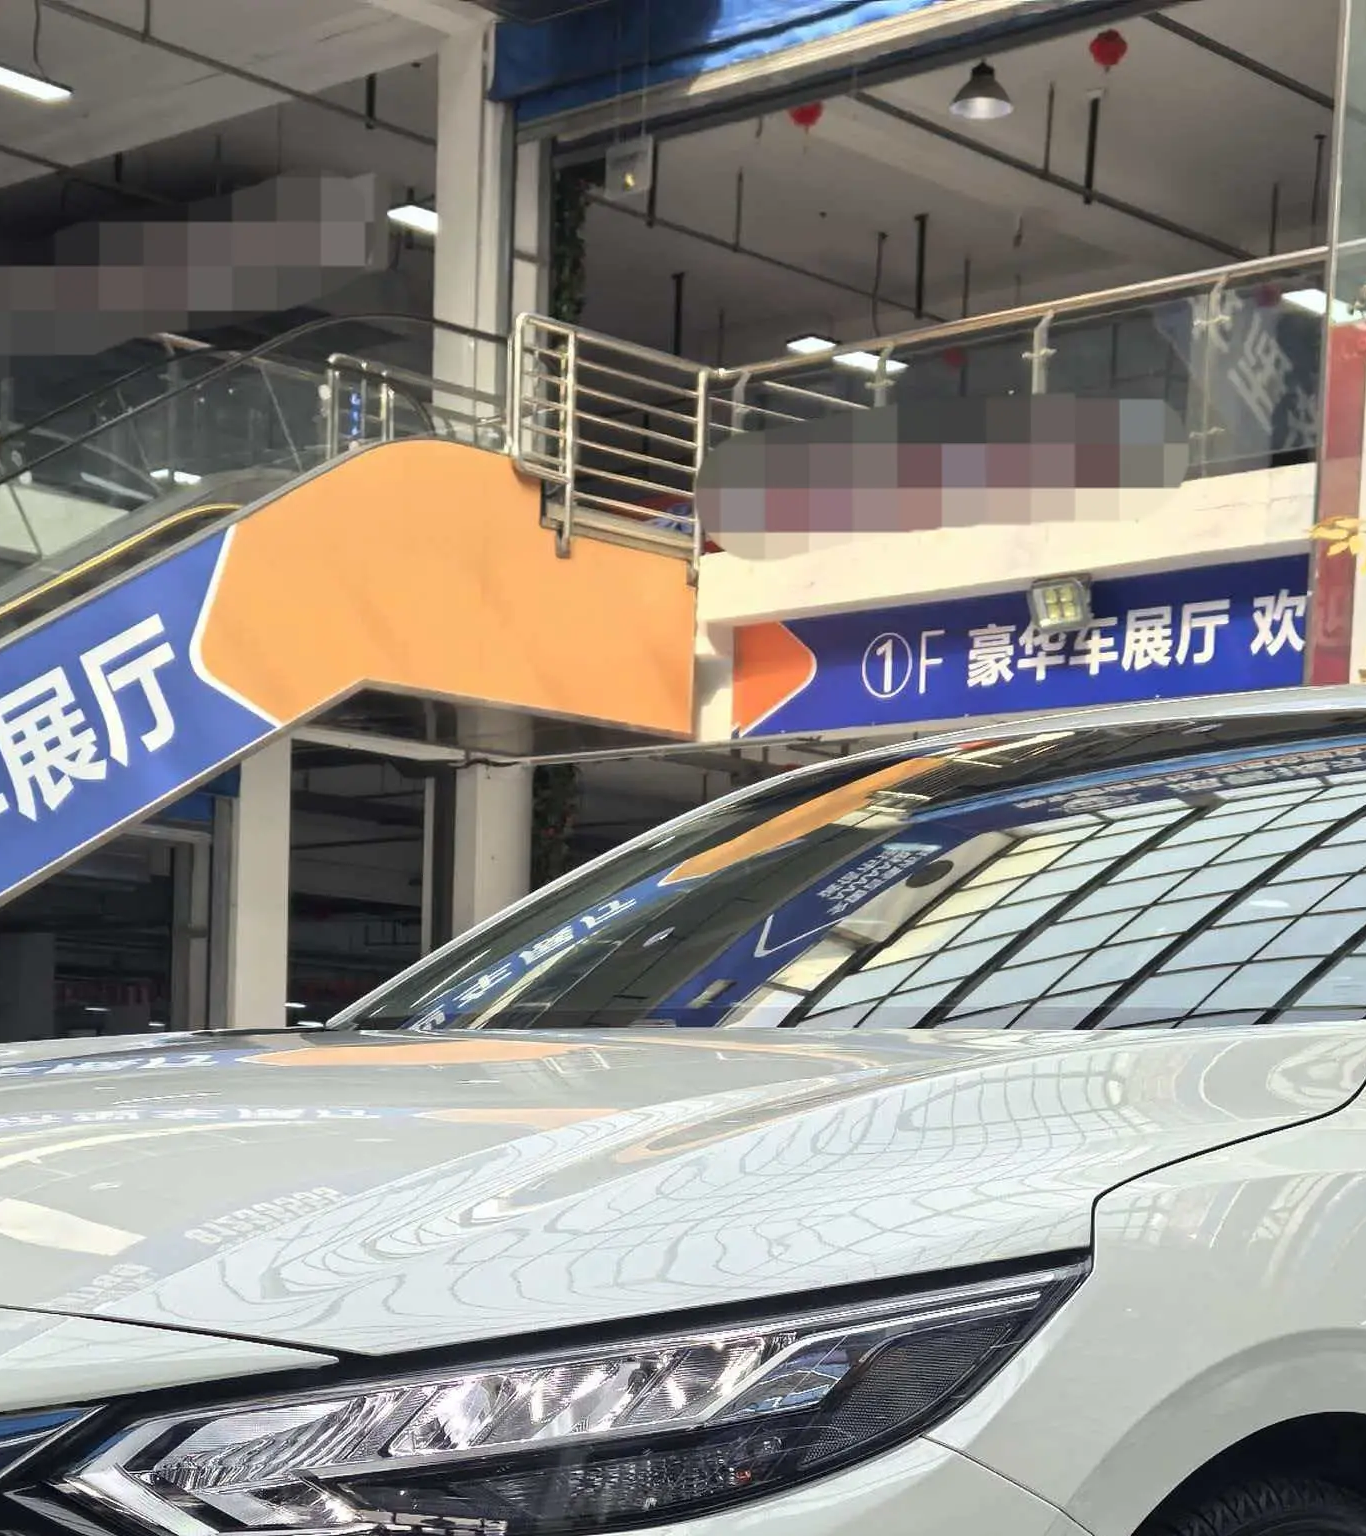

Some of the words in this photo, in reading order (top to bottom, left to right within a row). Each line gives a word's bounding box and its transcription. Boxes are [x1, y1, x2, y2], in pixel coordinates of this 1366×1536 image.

[966, 599, 1231, 688] 豪华车展厅
[1250, 590, 1306, 656] 欢
